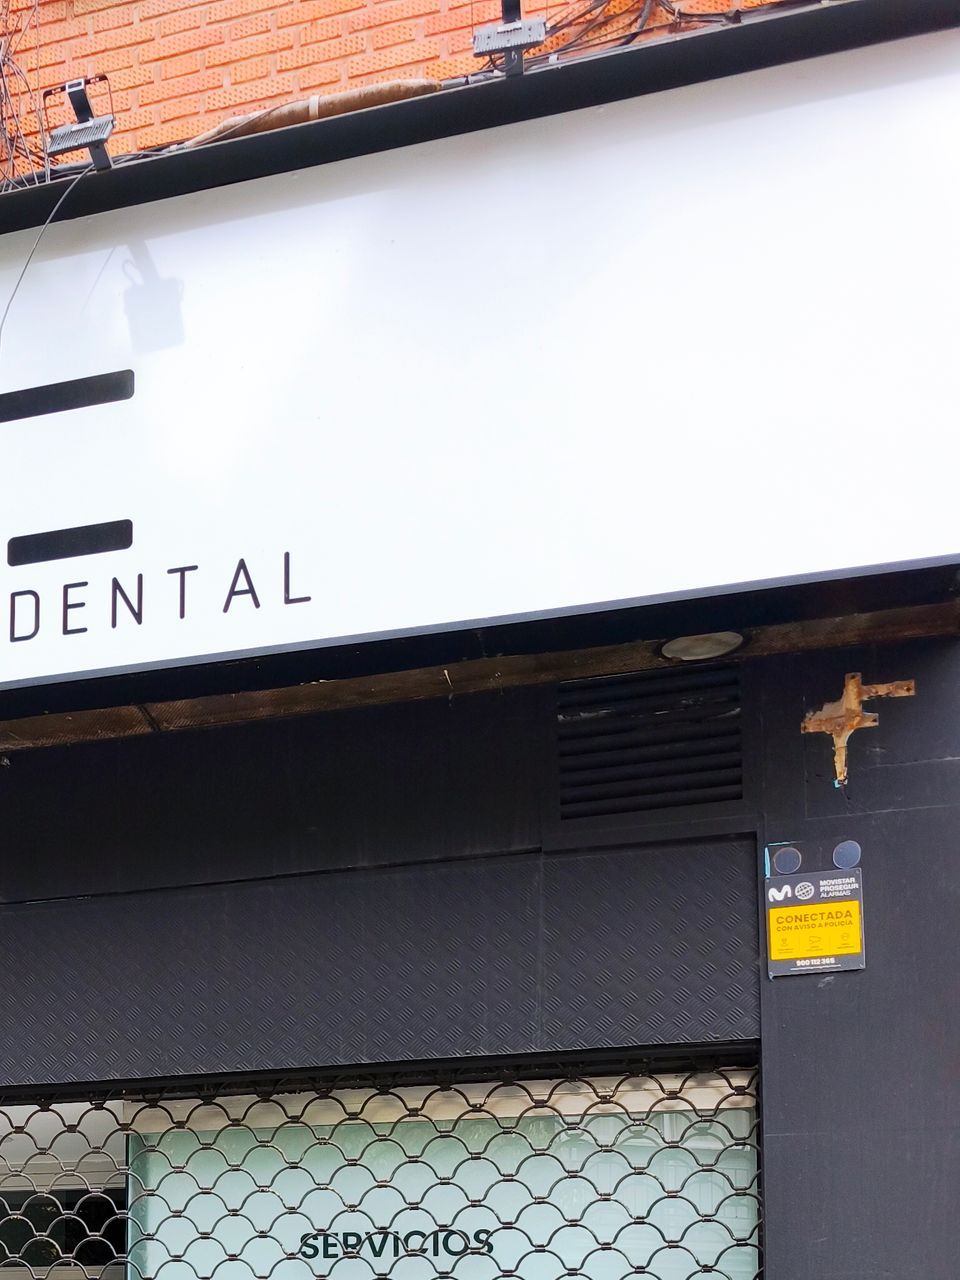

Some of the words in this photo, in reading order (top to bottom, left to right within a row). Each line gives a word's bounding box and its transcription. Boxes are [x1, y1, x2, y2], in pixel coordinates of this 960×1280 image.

[9, 551, 312, 643] DENTAL
[820, 884, 859, 892] PROSEGUR
[776, 910, 853, 925] CONECTADA
[300, 1228, 494, 1259] SERVICIOS
